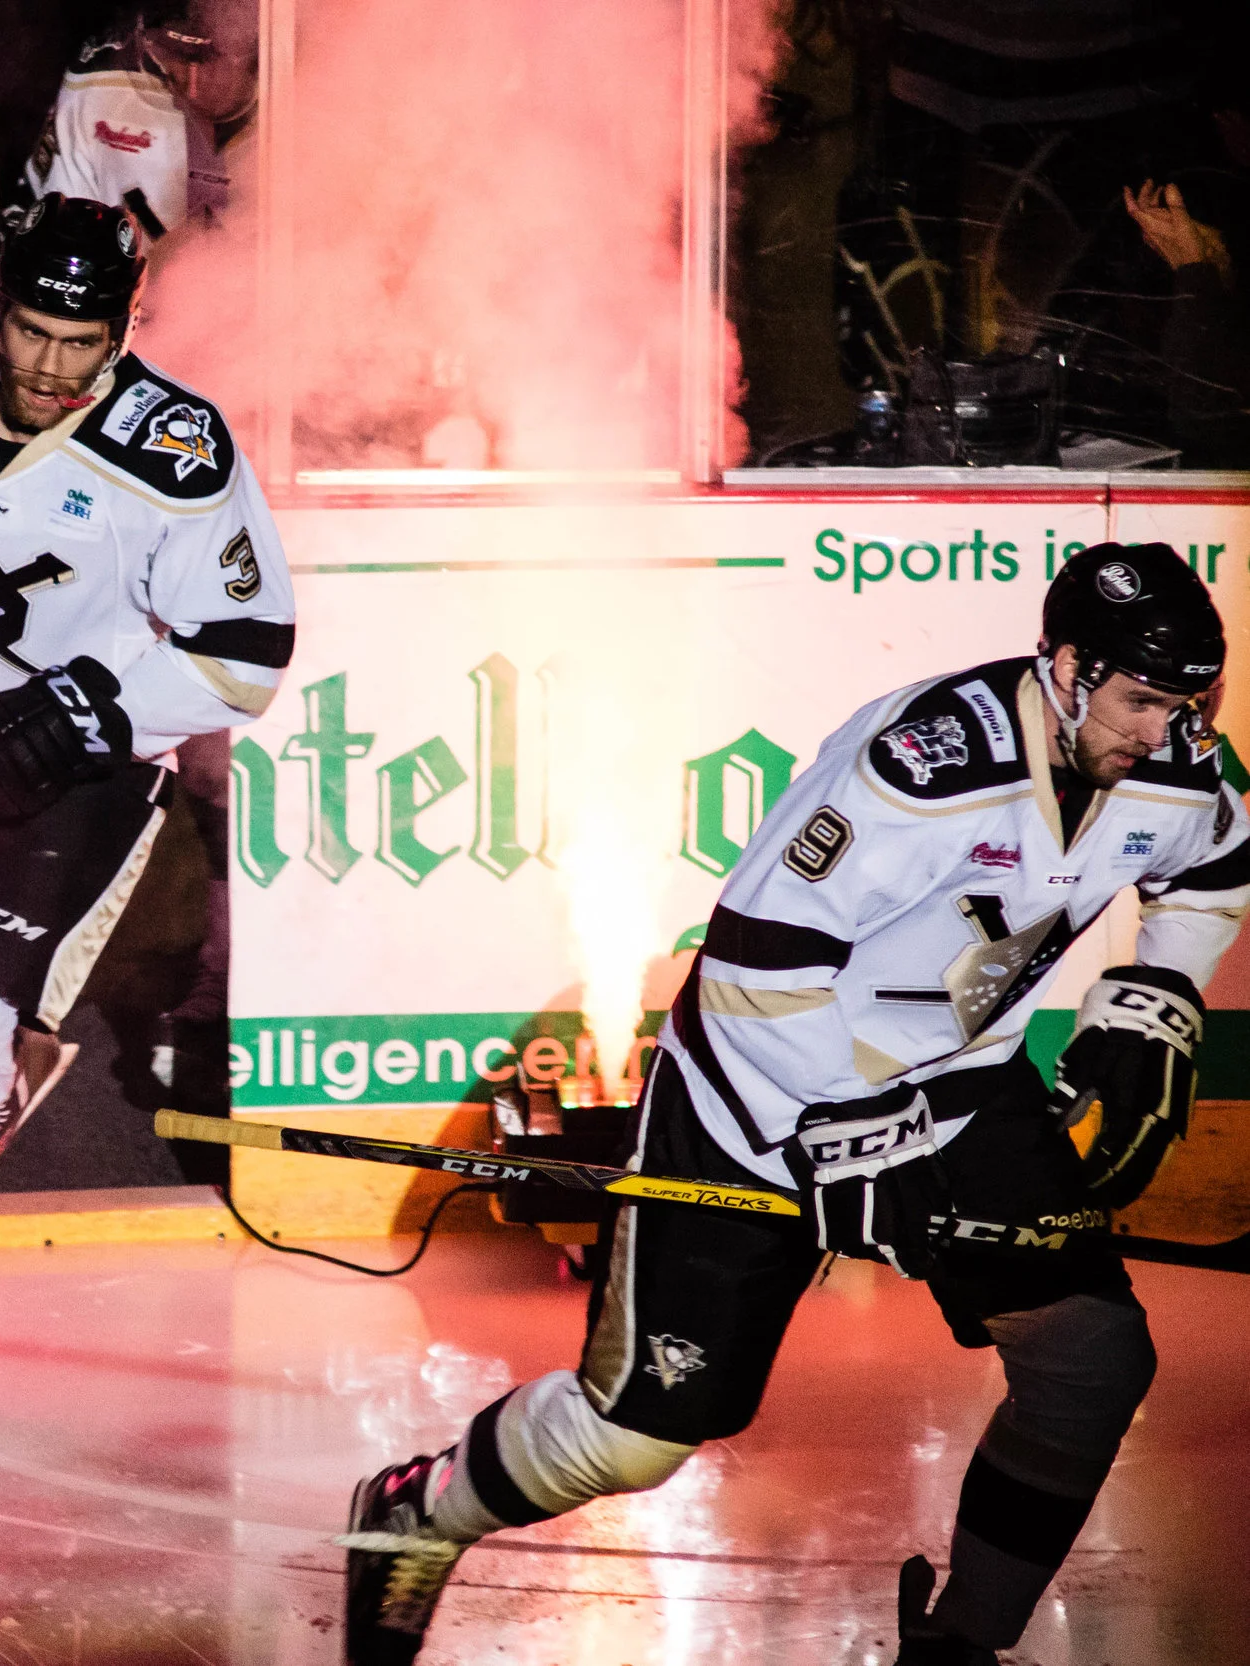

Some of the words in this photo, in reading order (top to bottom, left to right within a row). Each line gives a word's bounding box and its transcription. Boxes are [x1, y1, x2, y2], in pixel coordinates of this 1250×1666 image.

[37, 276, 87, 295] CCM
[219, 526, 262, 603] 3
[814, 528, 1020, 595] Sports
[1182, 664, 1221, 675] CCM
[46, 664, 111, 753] CM
[783, 804, 854, 883] 9
[1048, 874, 1083, 885] CCM
[1110, 987, 1198, 1042] CC
[810, 1109, 927, 1163] CCM
[441, 1158, 531, 1181] CCM
[642, 1187, 692, 1199] SUPER
[694, 1189, 773, 1211] TACKS
